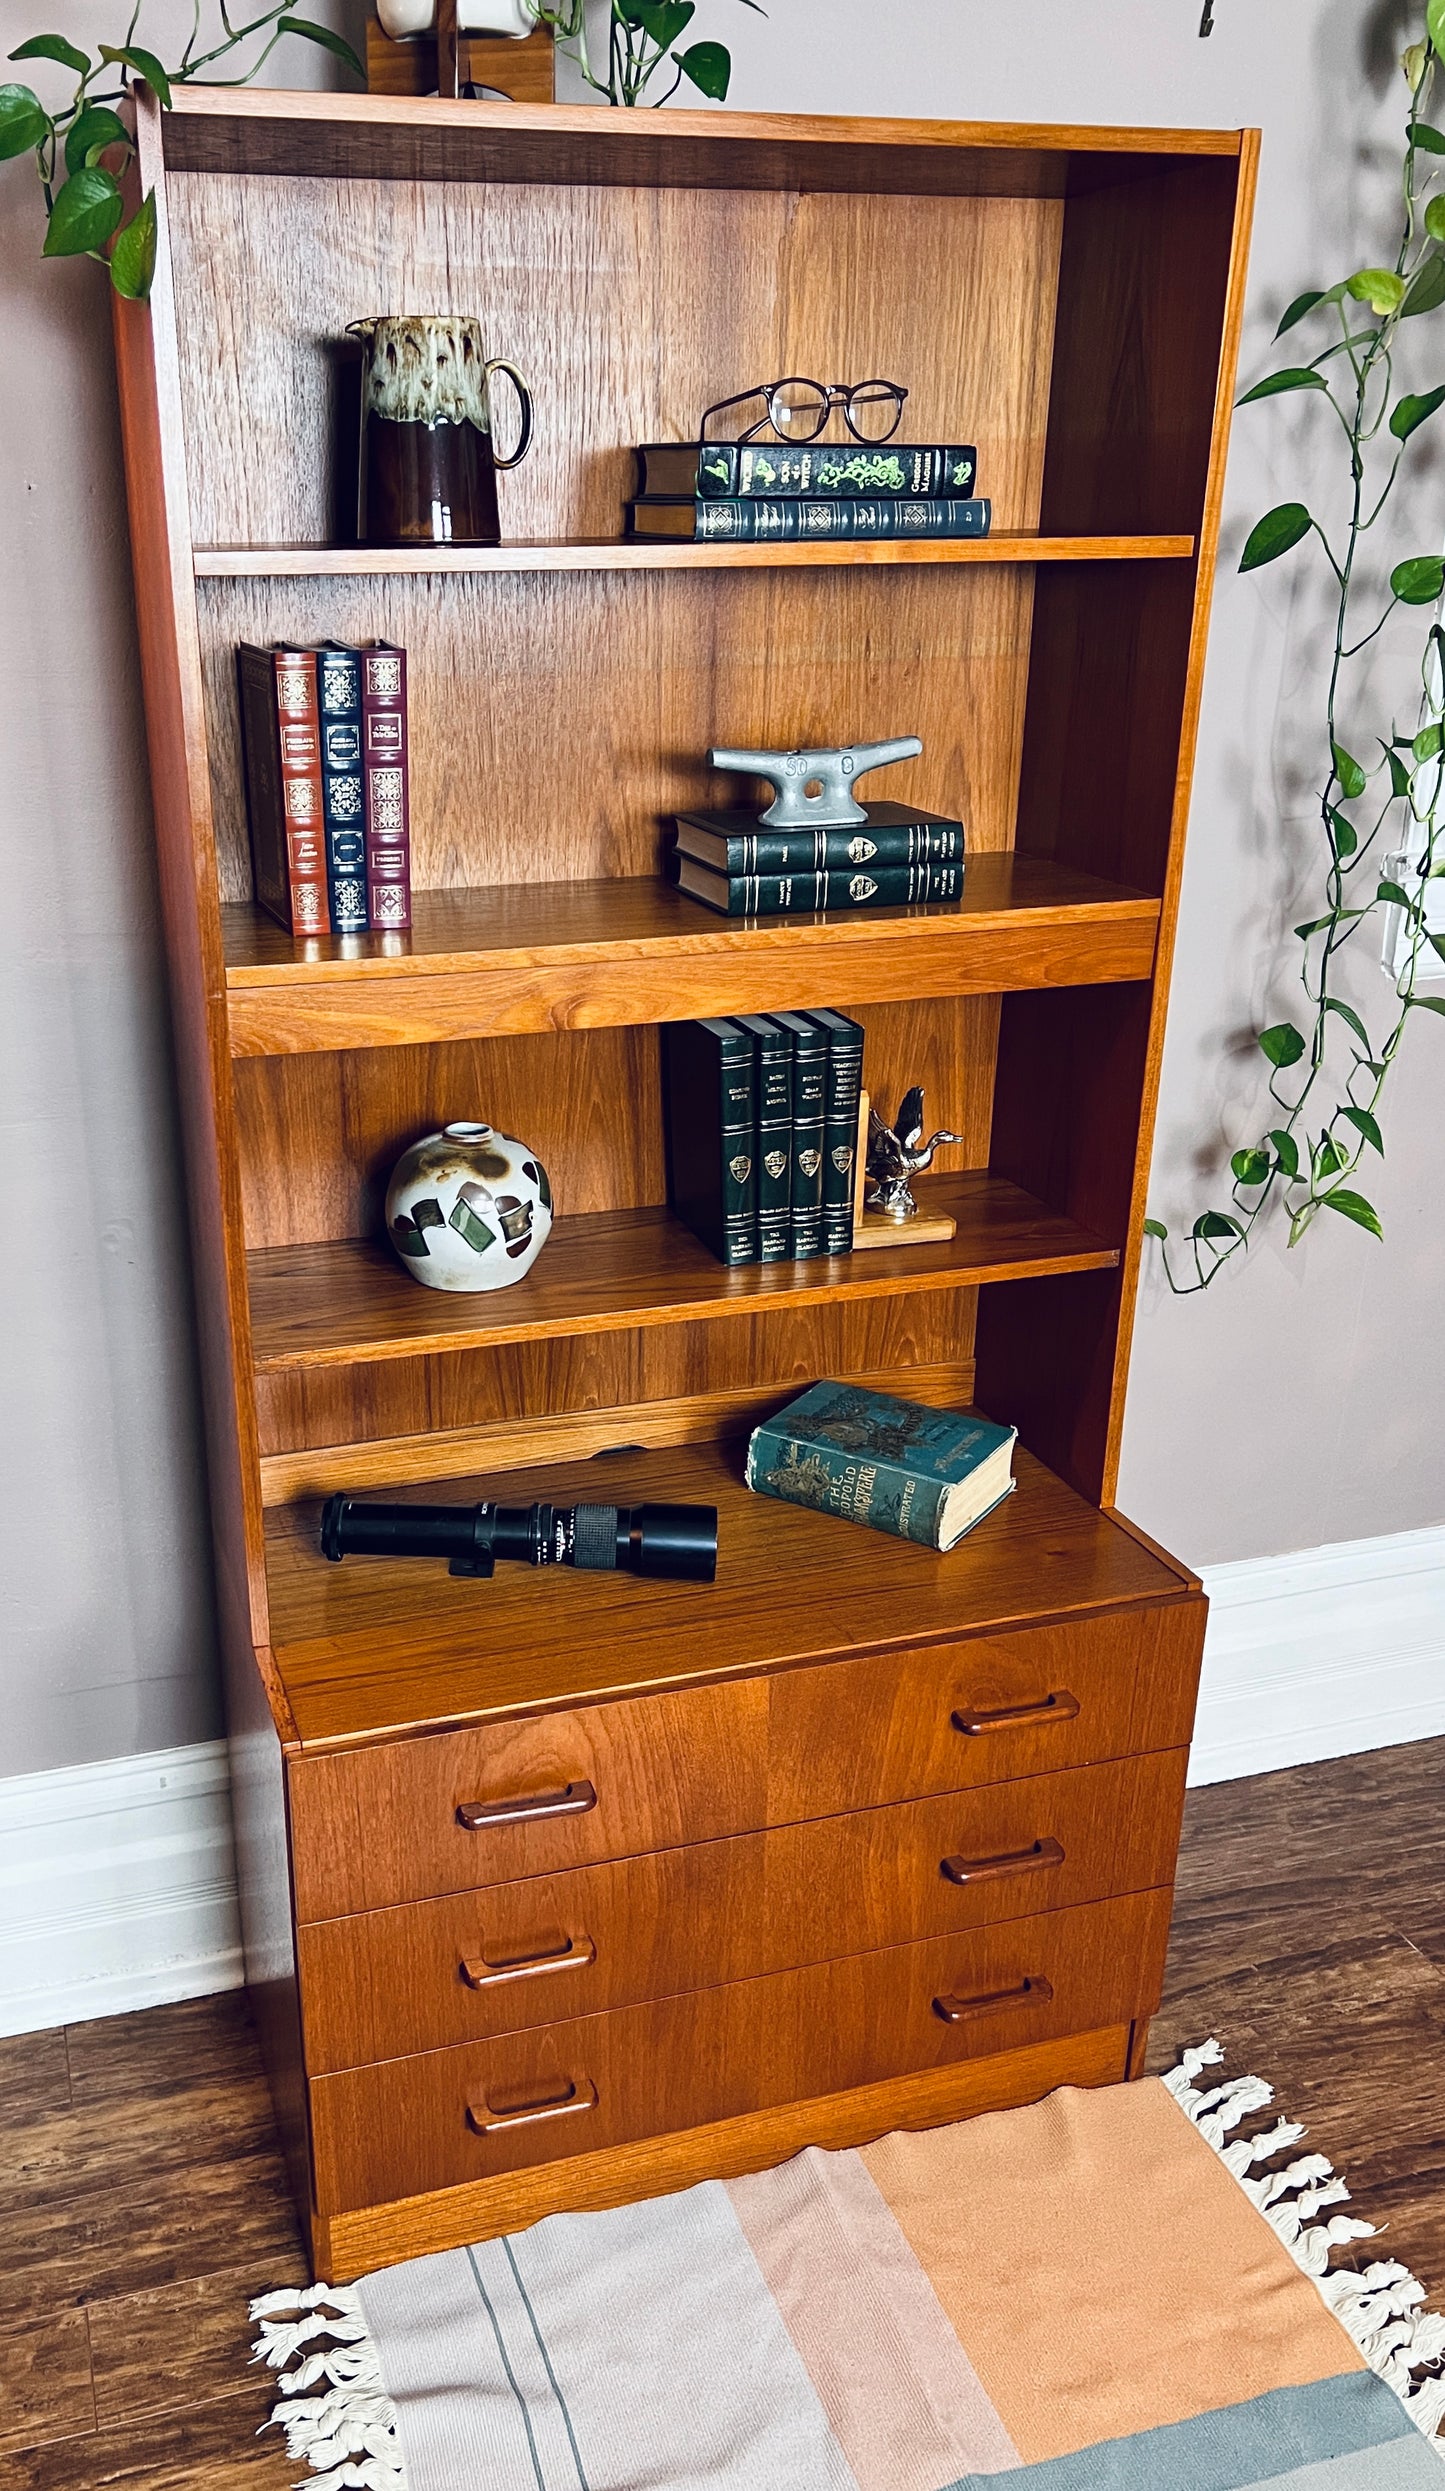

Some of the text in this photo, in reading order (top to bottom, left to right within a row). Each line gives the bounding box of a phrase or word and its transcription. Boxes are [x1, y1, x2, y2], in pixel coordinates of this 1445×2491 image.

[781, 460, 790, 484] SON
[801, 453, 812, 490] WITCH
[829, 1475, 844, 1507] THE
